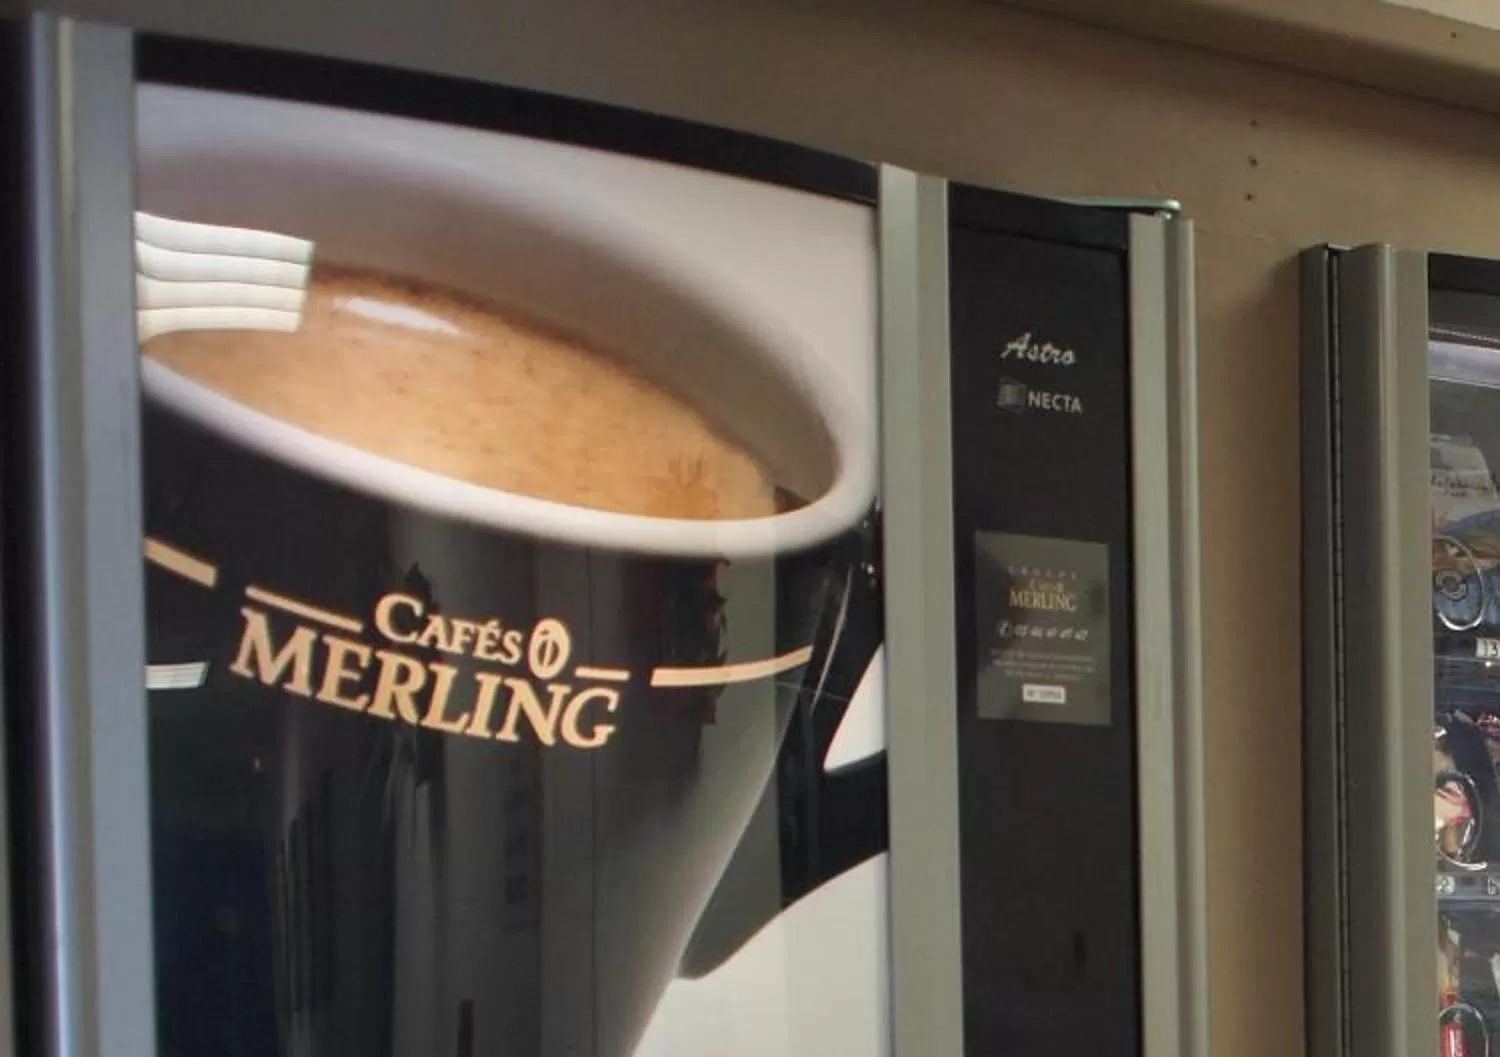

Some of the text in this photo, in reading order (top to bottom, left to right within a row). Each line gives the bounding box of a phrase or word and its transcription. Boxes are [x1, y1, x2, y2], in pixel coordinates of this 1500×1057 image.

[1001, 332, 1077, 366] Astro
[1027, 390, 1085, 414] NECTA
[230, 606, 619, 749] MERLING
